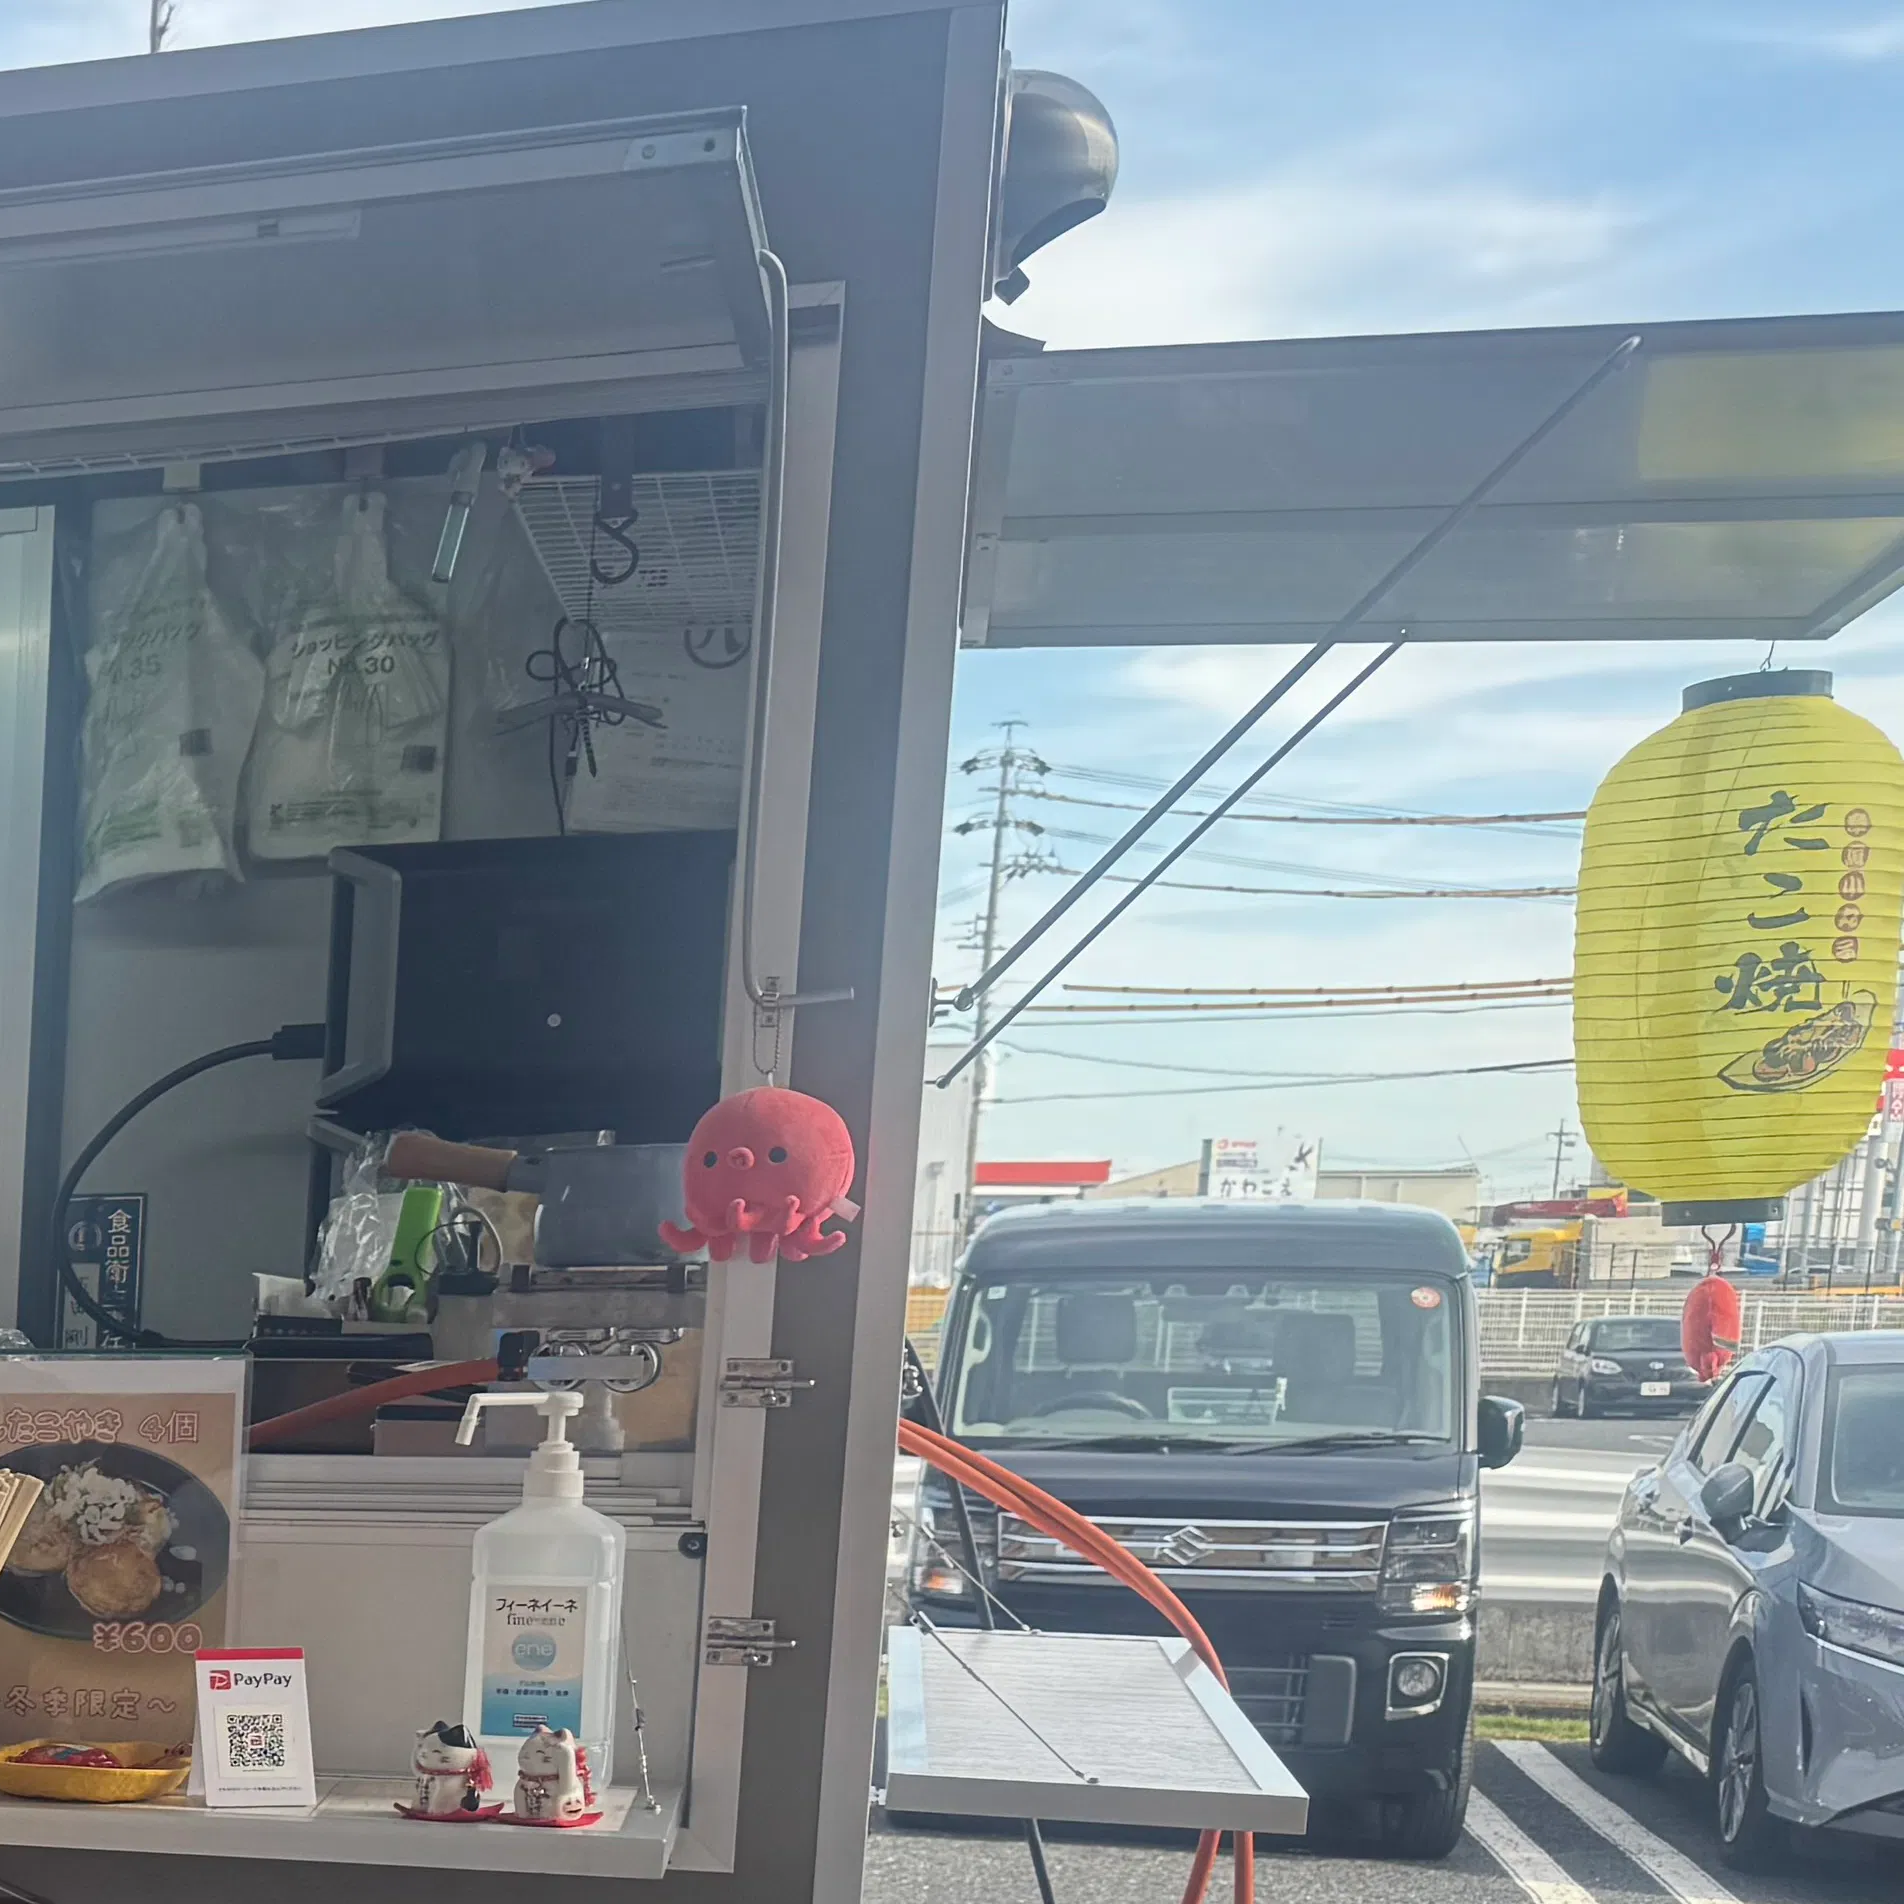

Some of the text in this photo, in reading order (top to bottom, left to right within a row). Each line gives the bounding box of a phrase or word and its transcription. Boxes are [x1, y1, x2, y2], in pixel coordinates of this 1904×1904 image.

[1715, 788, 1834, 1018] たこ焼
[138, 1410, 200, 1443] 4個
[496, 1598, 578, 1613] フィーネイーネ
[93, 1621, 203, 1653] ¥600
[234, 1672, 292, 1688] PayPay
